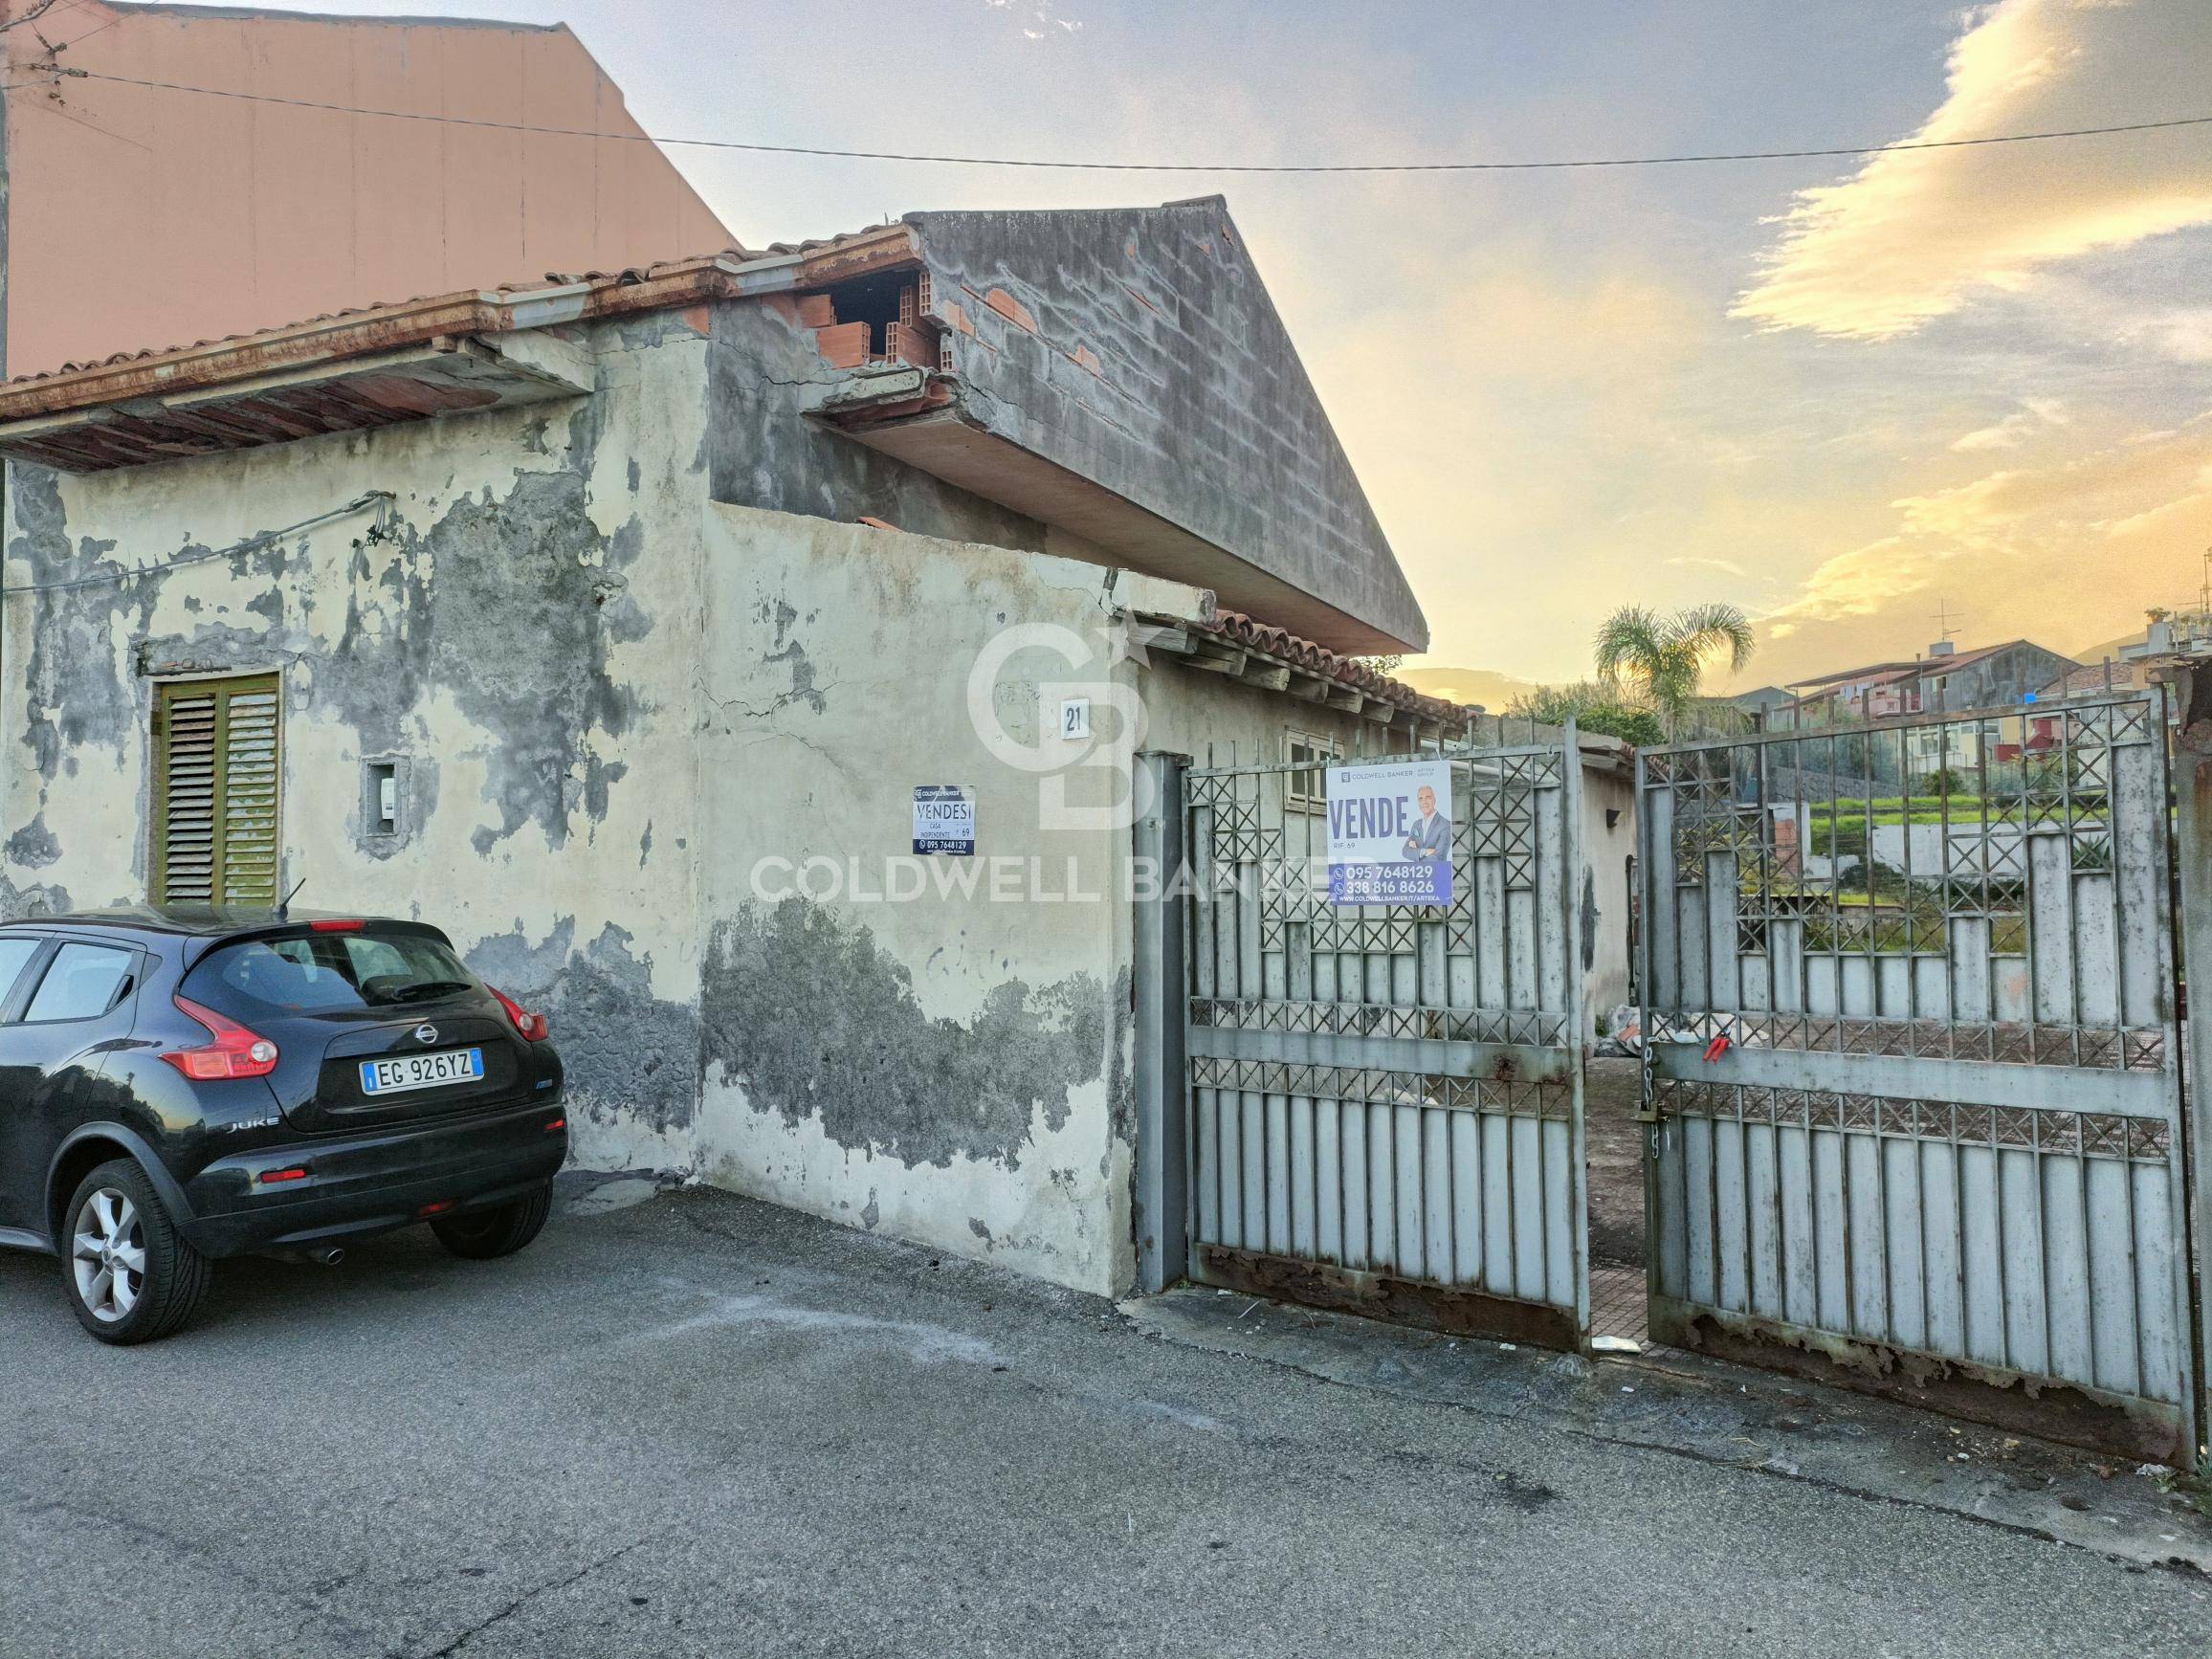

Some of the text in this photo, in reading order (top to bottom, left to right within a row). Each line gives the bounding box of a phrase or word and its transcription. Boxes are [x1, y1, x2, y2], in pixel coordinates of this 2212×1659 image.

[1066, 706, 1081, 732] 21
[1387, 770, 1413, 779] BANKER
[917, 804, 971, 820] VENDESI
[1329, 796, 1409, 839] VENDE
[962, 829, 970, 837] 69
[926, 841, 966, 850] 095 7648129
[1345, 866, 1433, 879] 095 7648129
[1346, 880, 1434, 894] 338 816 8626
[377, 1053, 471, 1087] EG 926YZ
[226, 1117, 279, 1134] JUKE
